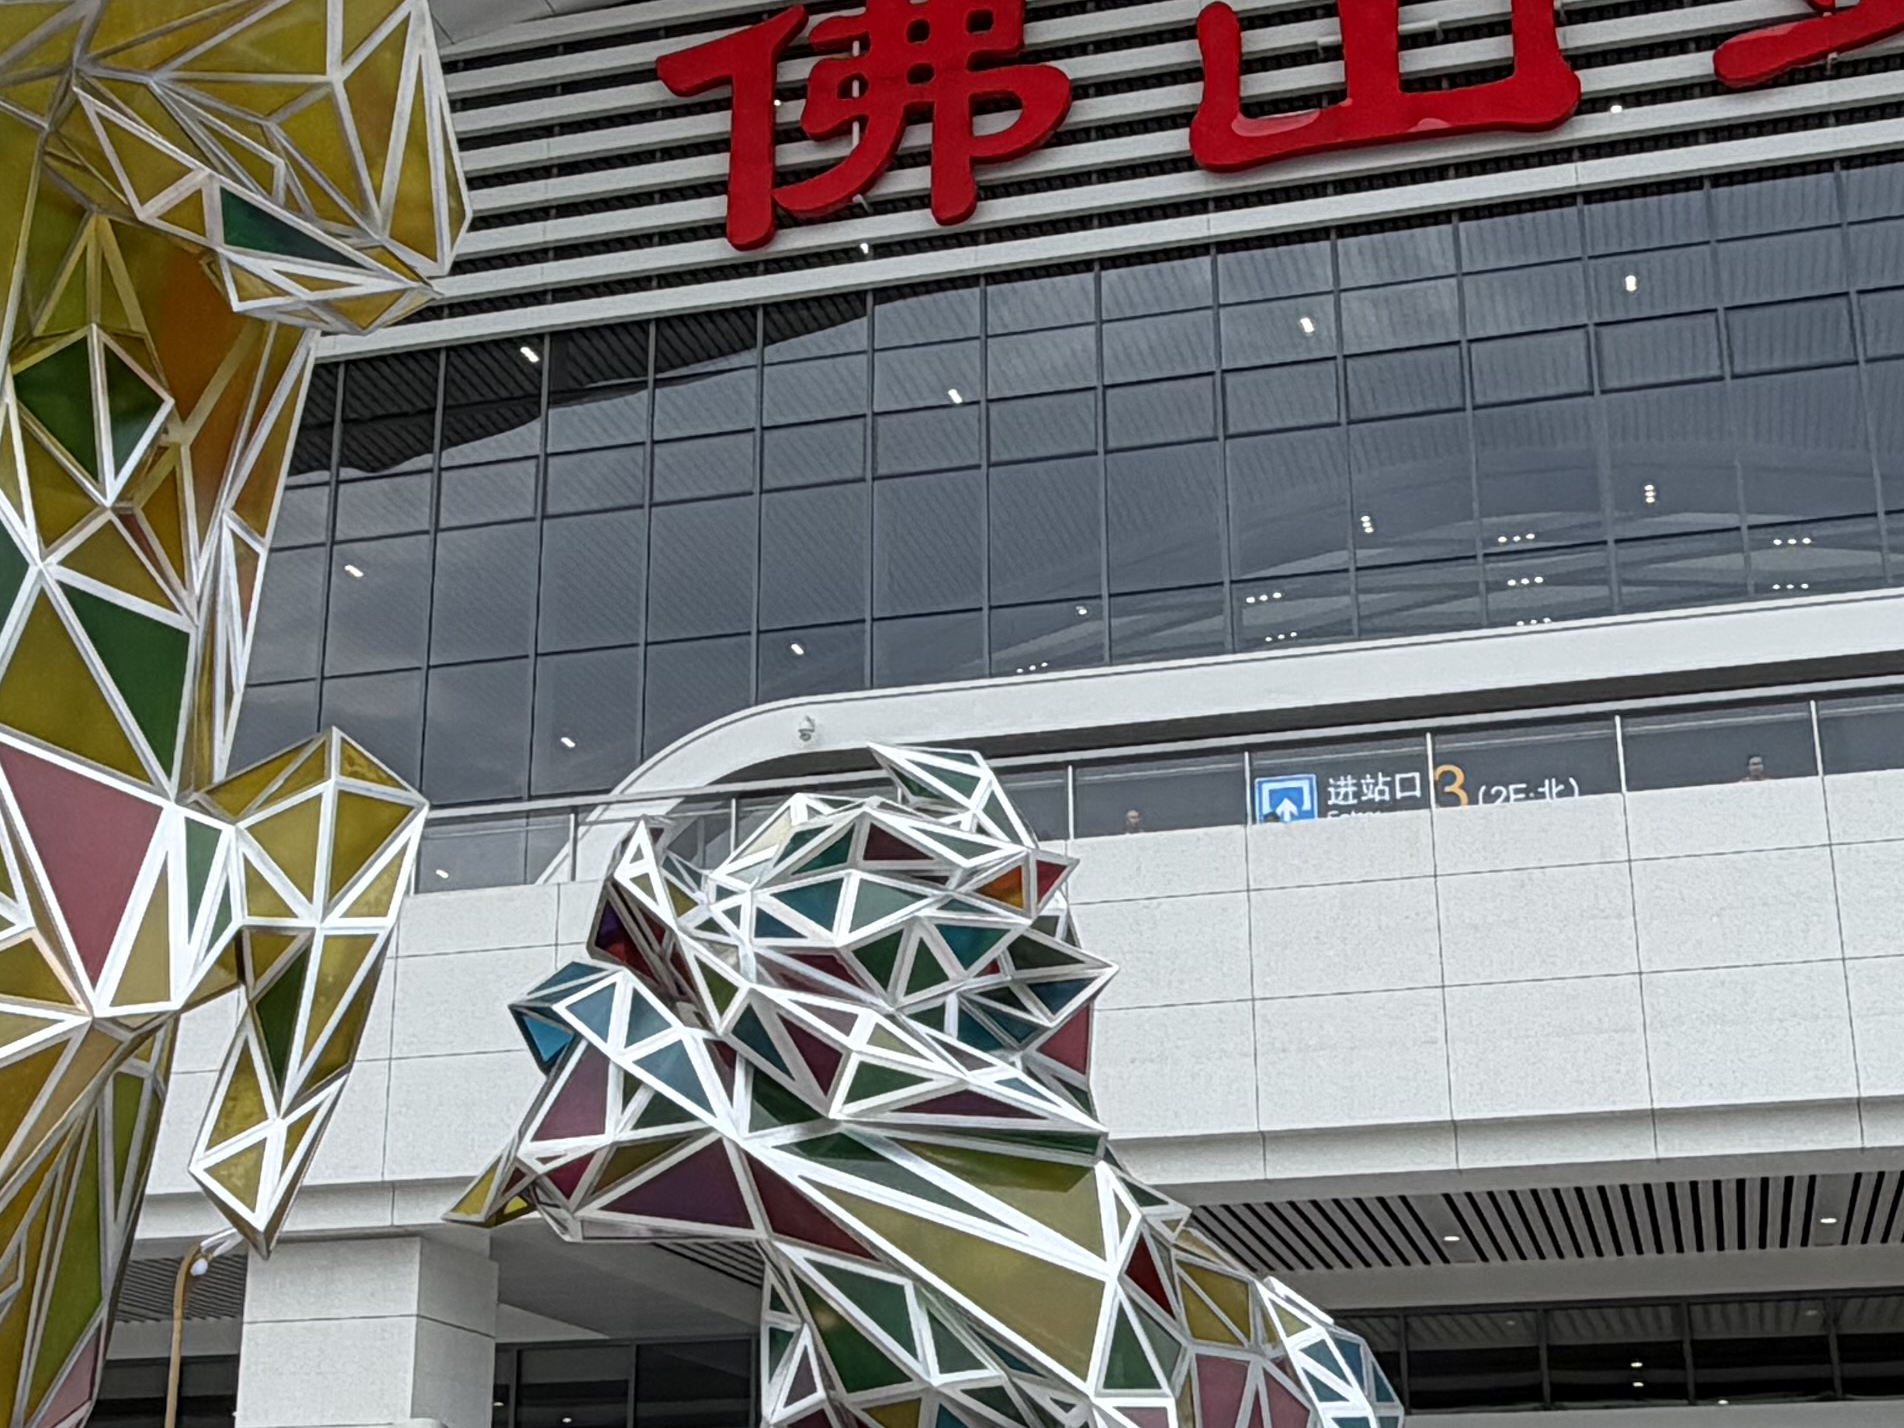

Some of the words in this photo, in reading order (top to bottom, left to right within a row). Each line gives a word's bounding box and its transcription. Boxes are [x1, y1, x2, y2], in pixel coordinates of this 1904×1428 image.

[1327, 771, 1422, 806] 进站口
[1434, 765, 1470, 808] 3
